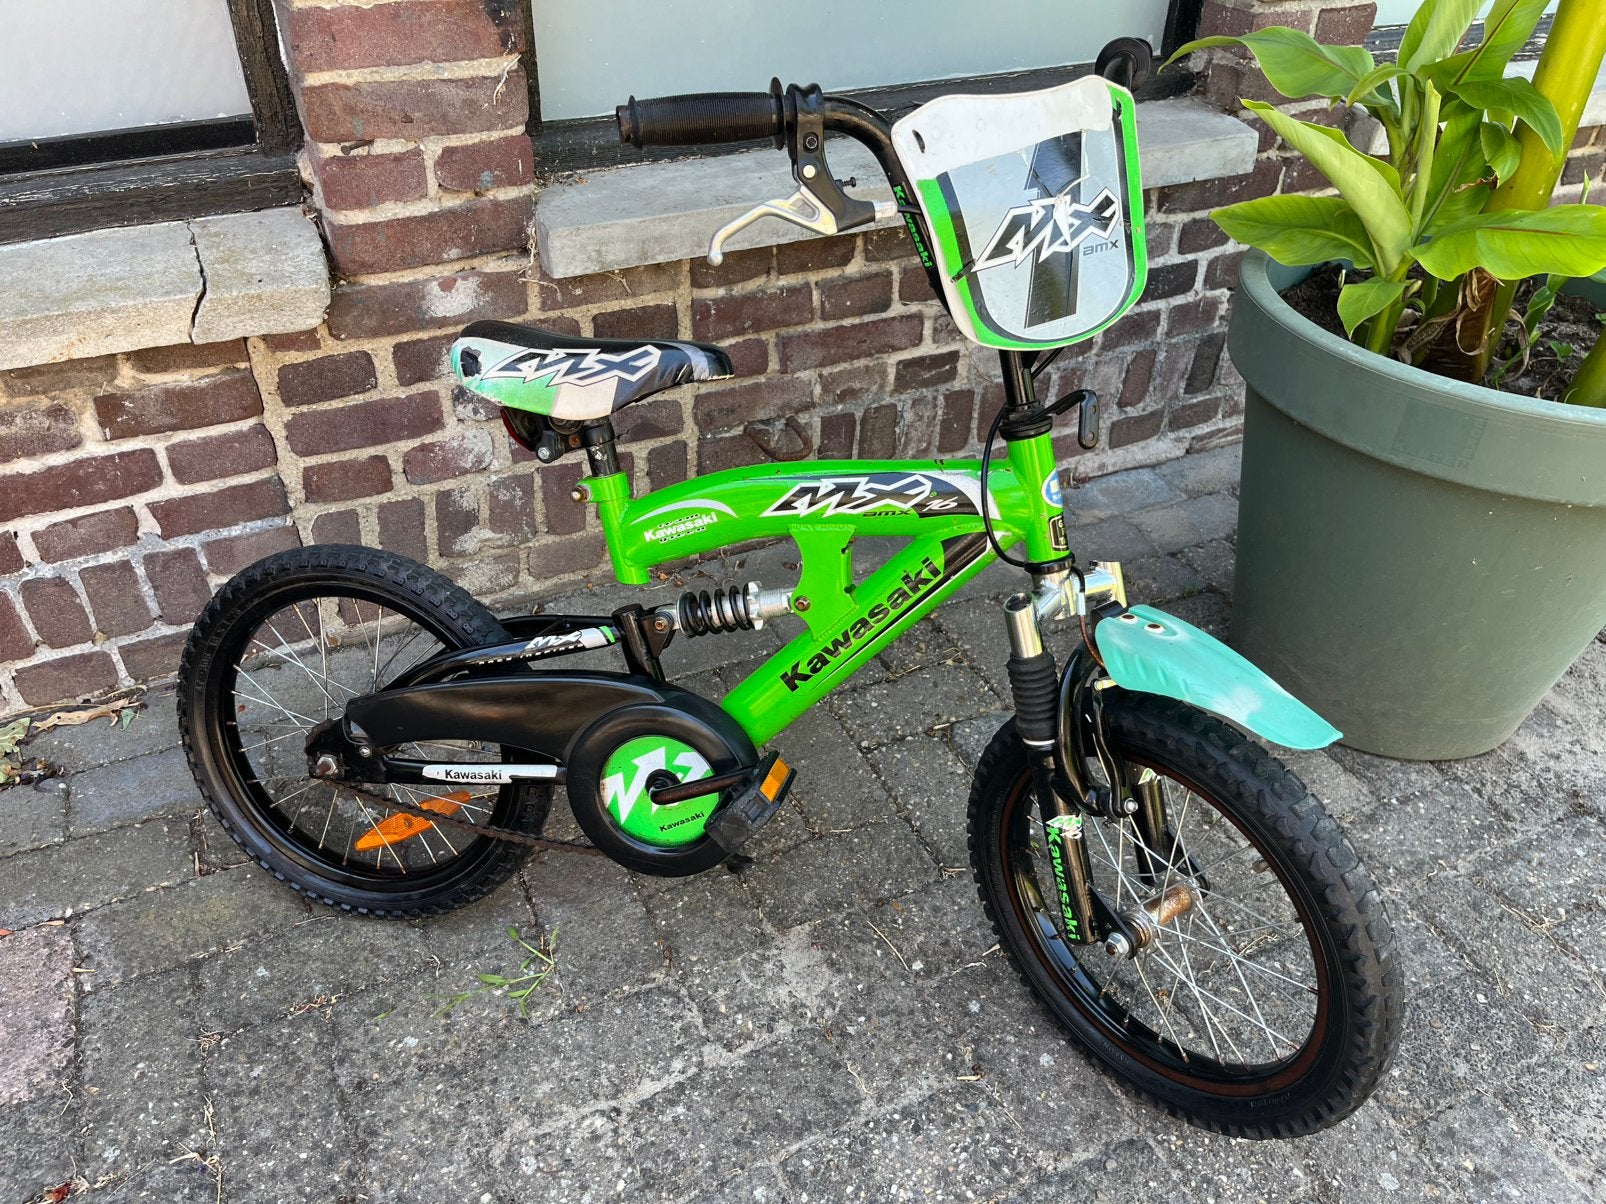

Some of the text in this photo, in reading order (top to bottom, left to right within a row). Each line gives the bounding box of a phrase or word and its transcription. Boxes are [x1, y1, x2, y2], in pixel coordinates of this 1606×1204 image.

[1083, 239, 1119, 256] amx
[863, 509, 911, 518] amx
[922, 496, 958, 512] 16
[643, 511, 719, 542] Kawasaki
[779, 556, 943, 693] Kawasaki
[444, 769, 502, 780] Kawasaki
[659, 811, 705, 832] Kawasaki
[1046, 826, 1081, 942] Kawasaki
